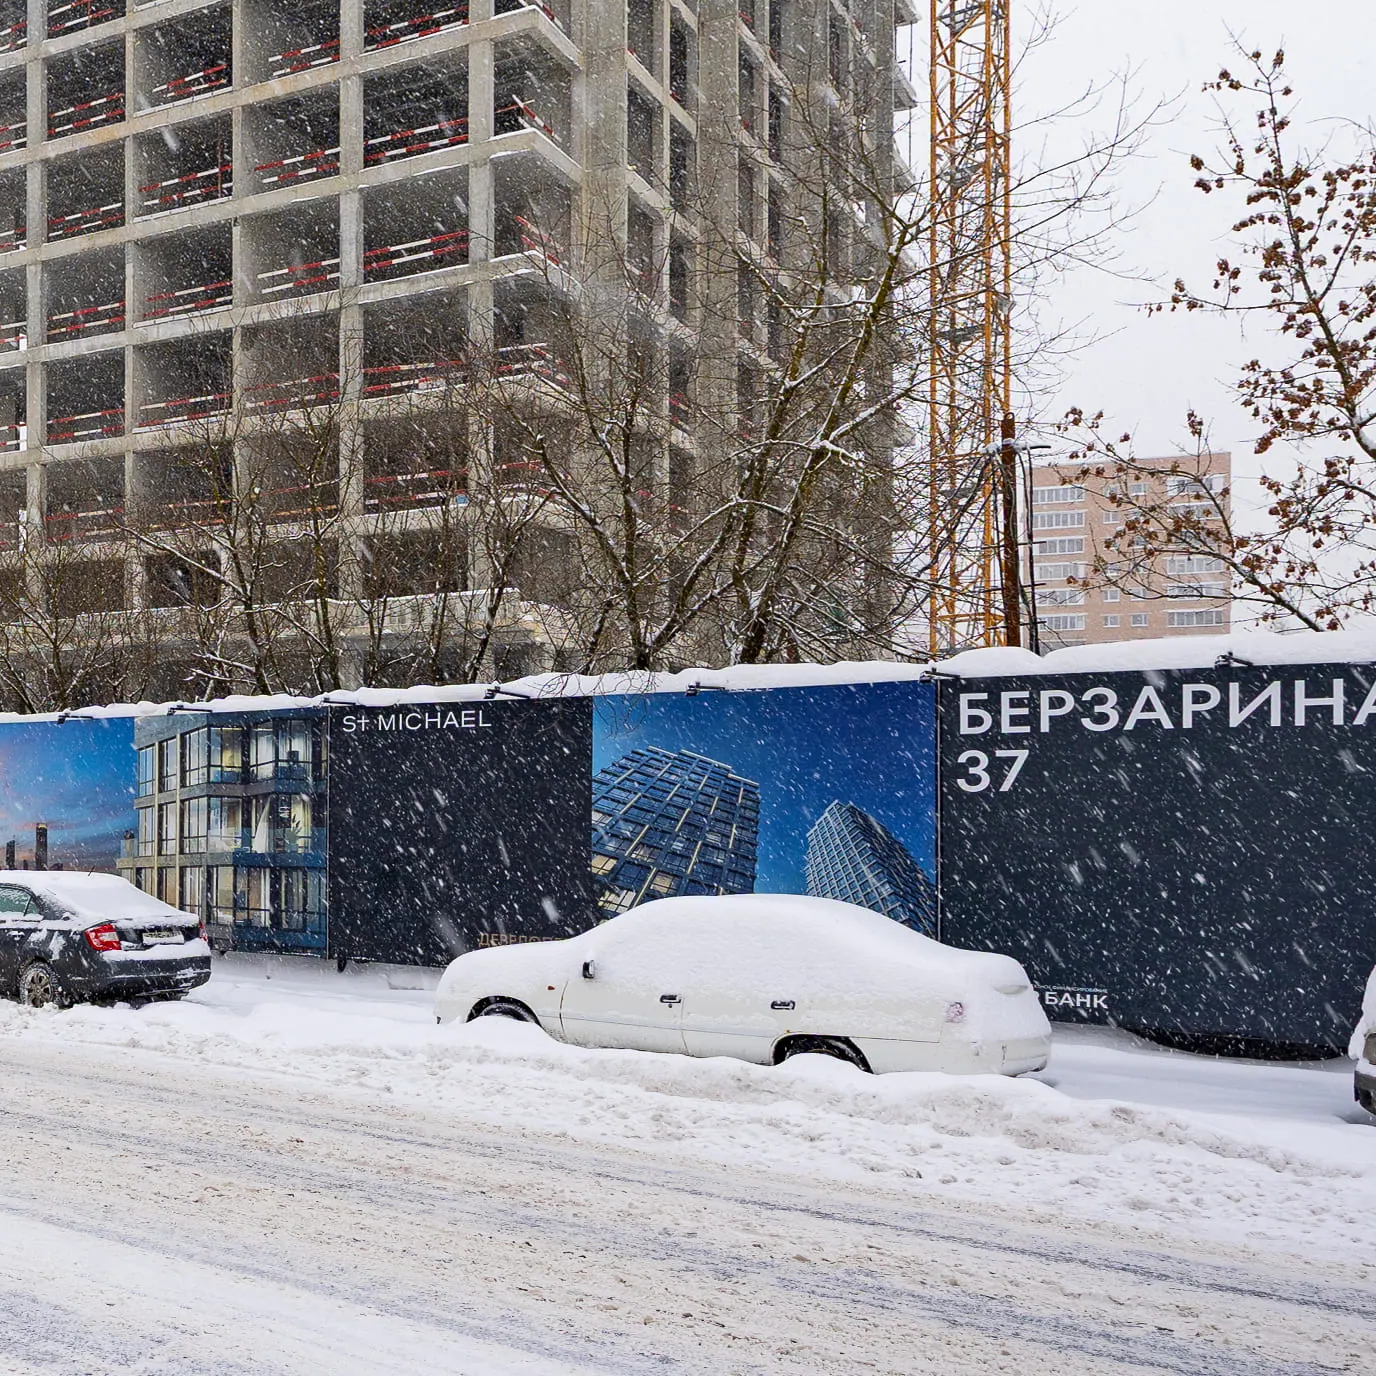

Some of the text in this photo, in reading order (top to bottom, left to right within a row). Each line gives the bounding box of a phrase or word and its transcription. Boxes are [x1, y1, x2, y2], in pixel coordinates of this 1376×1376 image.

[342, 710, 492, 732] St MICHAEL
[956, 749, 1029, 792] 37
[1045, 991, 1109, 1009] БАНК
